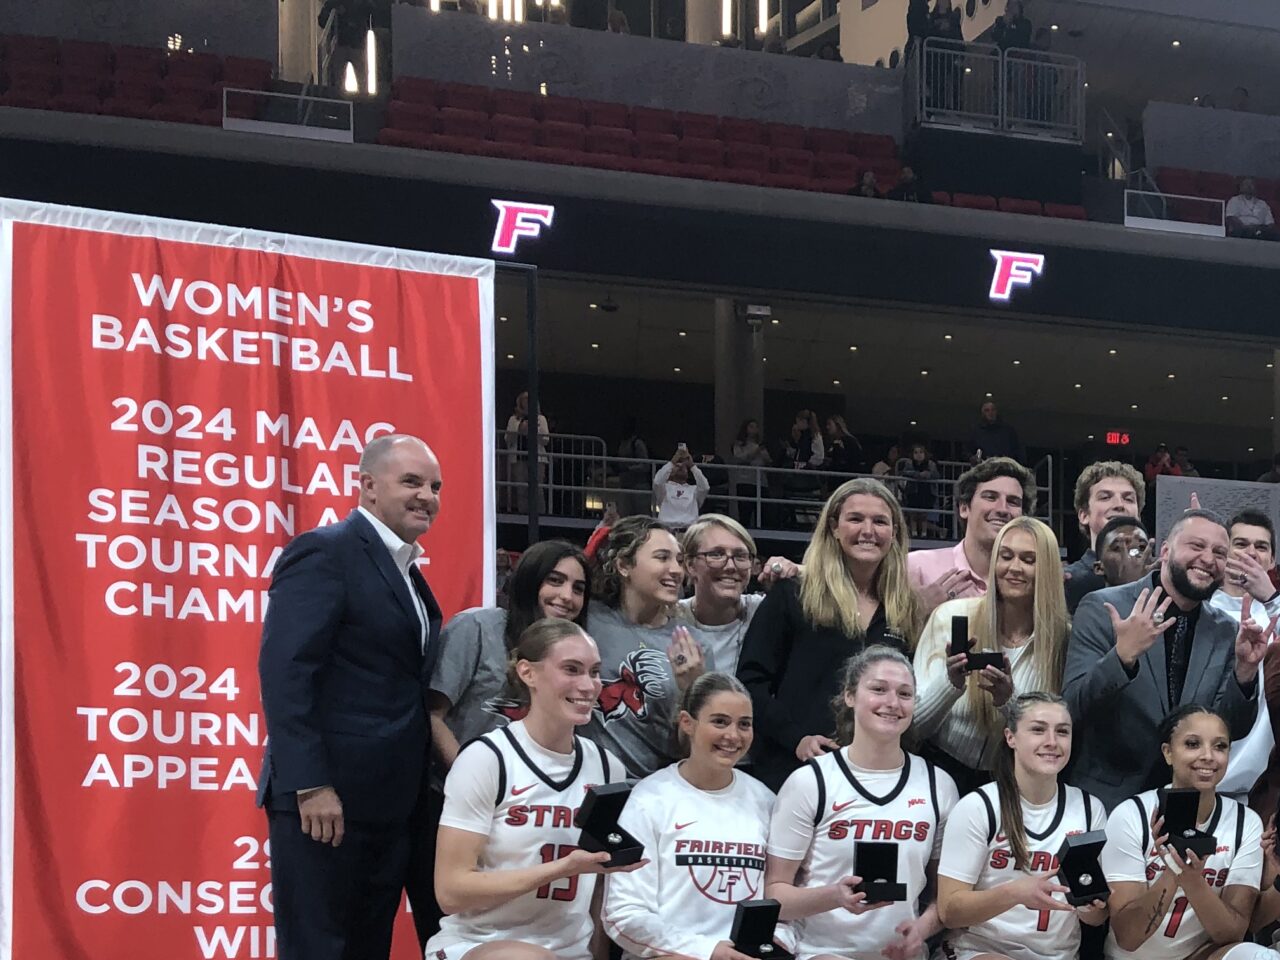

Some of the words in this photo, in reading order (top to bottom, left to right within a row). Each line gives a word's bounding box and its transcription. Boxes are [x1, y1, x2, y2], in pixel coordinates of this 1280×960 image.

[490, 199, 555, 254] F
[989, 249, 1045, 301] F
[132, 273, 374, 333] WOMEN'S
[92, 314, 413, 382] BASKETBALL
[111, 397, 236, 441] 2024
[138, 444, 360, 497] REGULAR
[88, 488, 295, 536] SEASON
[114, 661, 240, 701] 2024
[77, 707, 268, 747] TOURN
[82, 753, 259, 791] APPEA
[675, 839, 765, 858] FAIRFIEL
[828, 819, 930, 842] STAGS
